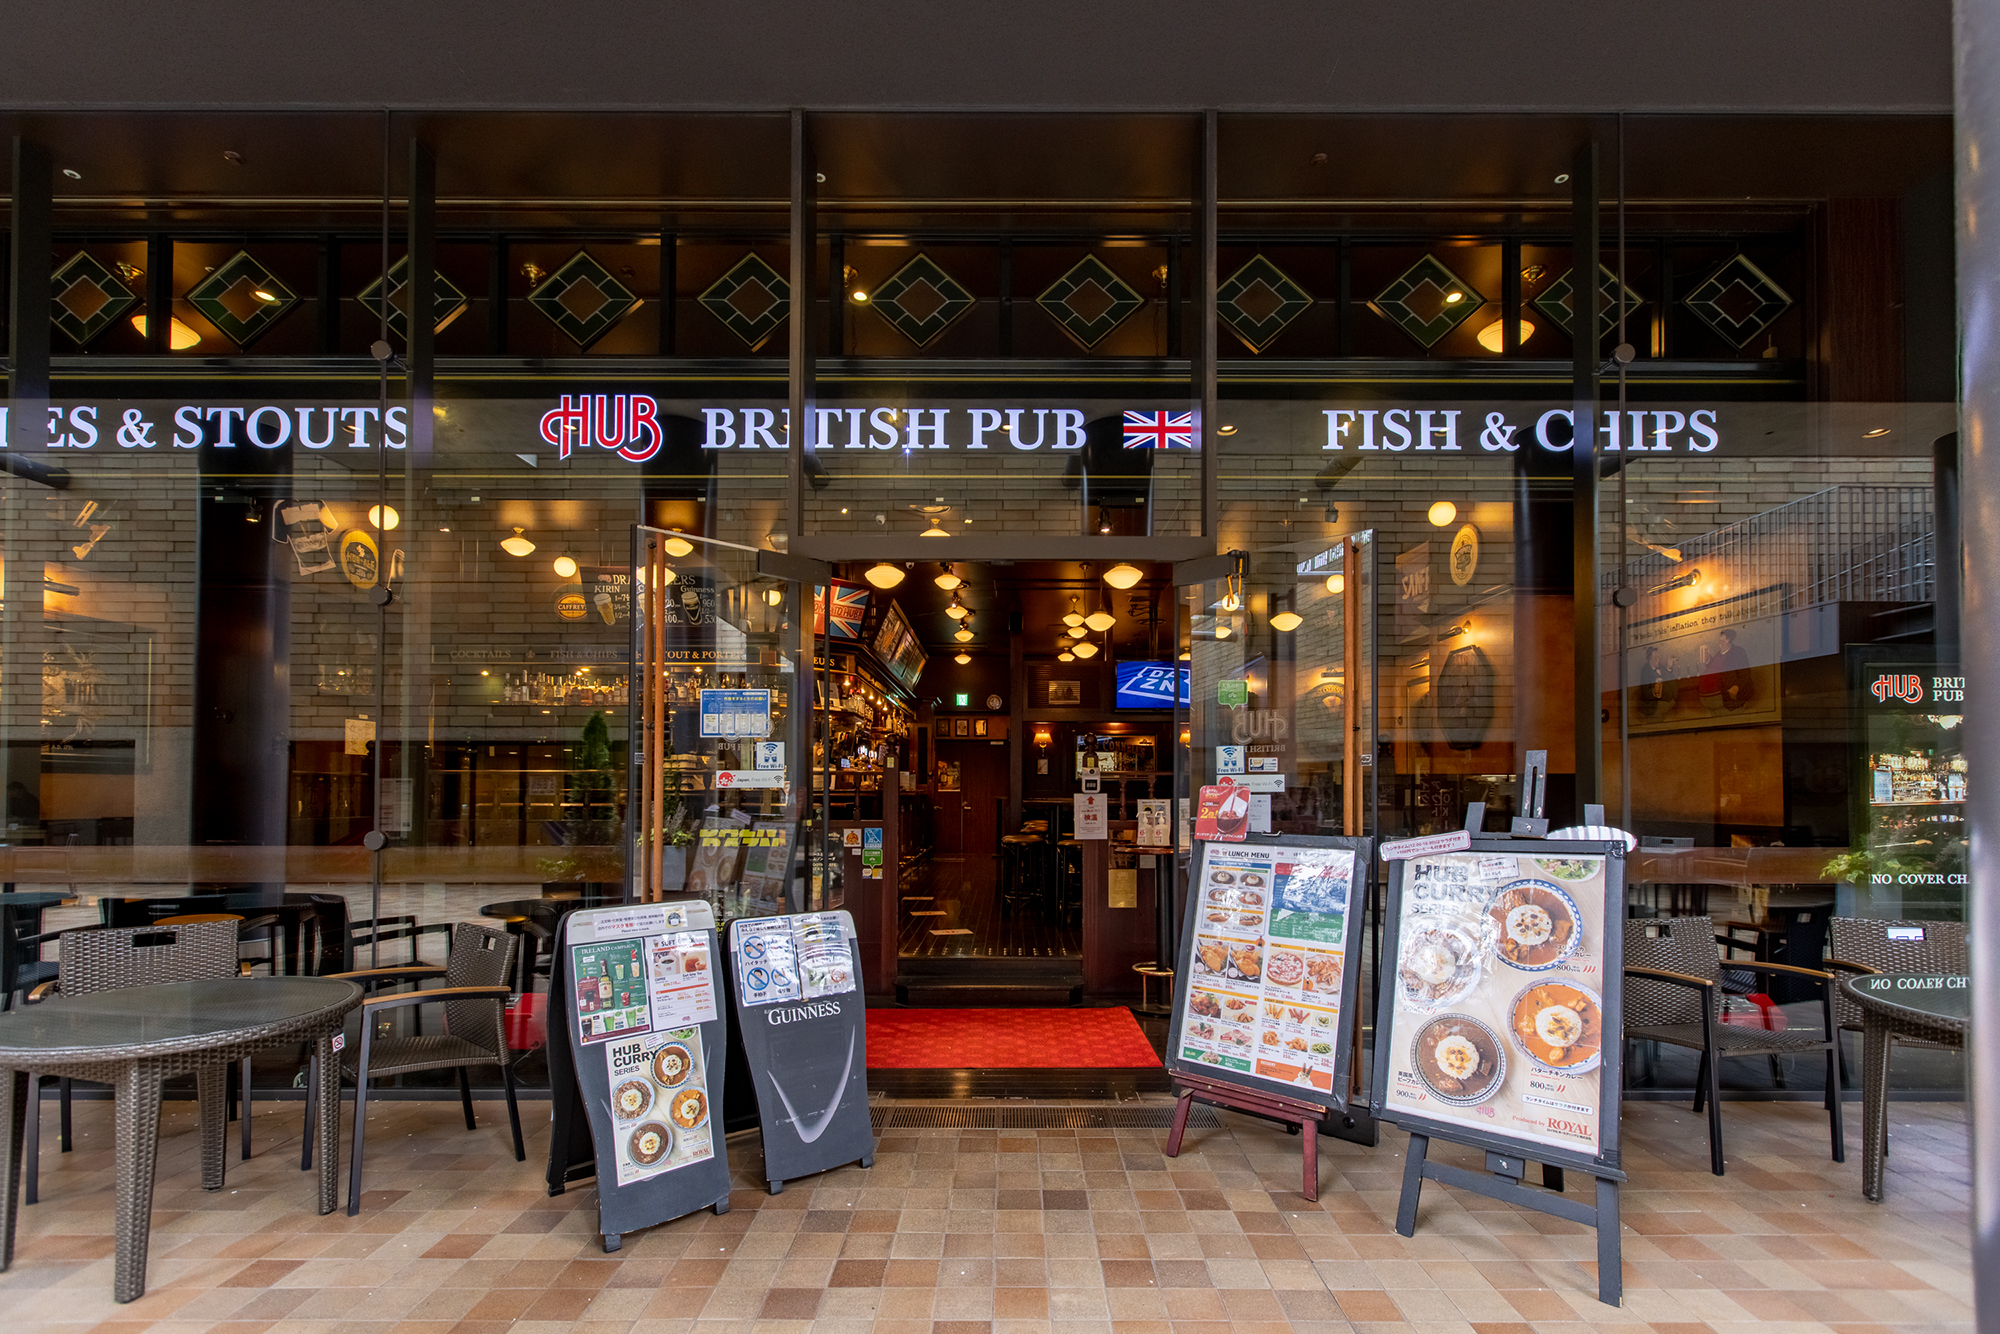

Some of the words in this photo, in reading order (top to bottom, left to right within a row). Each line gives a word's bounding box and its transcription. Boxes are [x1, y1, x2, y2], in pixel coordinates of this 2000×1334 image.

[0, 407, 98, 448] ES
[117, 408, 157, 447] &
[173, 406, 407, 449] STOUTS
[540, 393, 664, 463] HUB
[967, 408, 1087, 450] PUB
[1322, 409, 1461, 452] FISH
[1479, 411, 1521, 452] &
[1536, 409, 1719, 452] CHIPS
[594, 585, 621, 593] KIRIN
[680, 585, 715, 593] Guinness
[1701, 615, 1717, 626] they
[450, 650, 511, 659] COCKTAILS
[550, 650, 574, 659] FISH
[586, 650, 618, 659] CHIPS
[691, 651, 699, 659] &
[1871, 674, 1923, 704] HUB
[1932, 690, 1964, 702] PUB
[1415, 864, 1468, 882] HUB
[1871, 874, 1892, 884] NO
[1898, 874, 1945, 884] COVER
[1947, 874, 1970, 884] CH
[1413, 883, 1503, 905] CURRY
[581, 946, 611, 955] IRELAND
[768, 1002, 841, 1026] GUINNESS
[613, 1043, 641, 1057] HUB
[613, 1050, 658, 1067] CURRY
[614, 1065, 640, 1077] SERIES
[1530, 1067, 1583, 1080] バターチキンカレー
[1530, 1080, 1545, 1089] 800
[1396, 1089, 1409, 1098] 900
[1476, 1106, 1495, 1118] HUB
[1512, 1115, 1537, 1125] Produced
[1547, 1117, 1592, 1137] ROYAL
